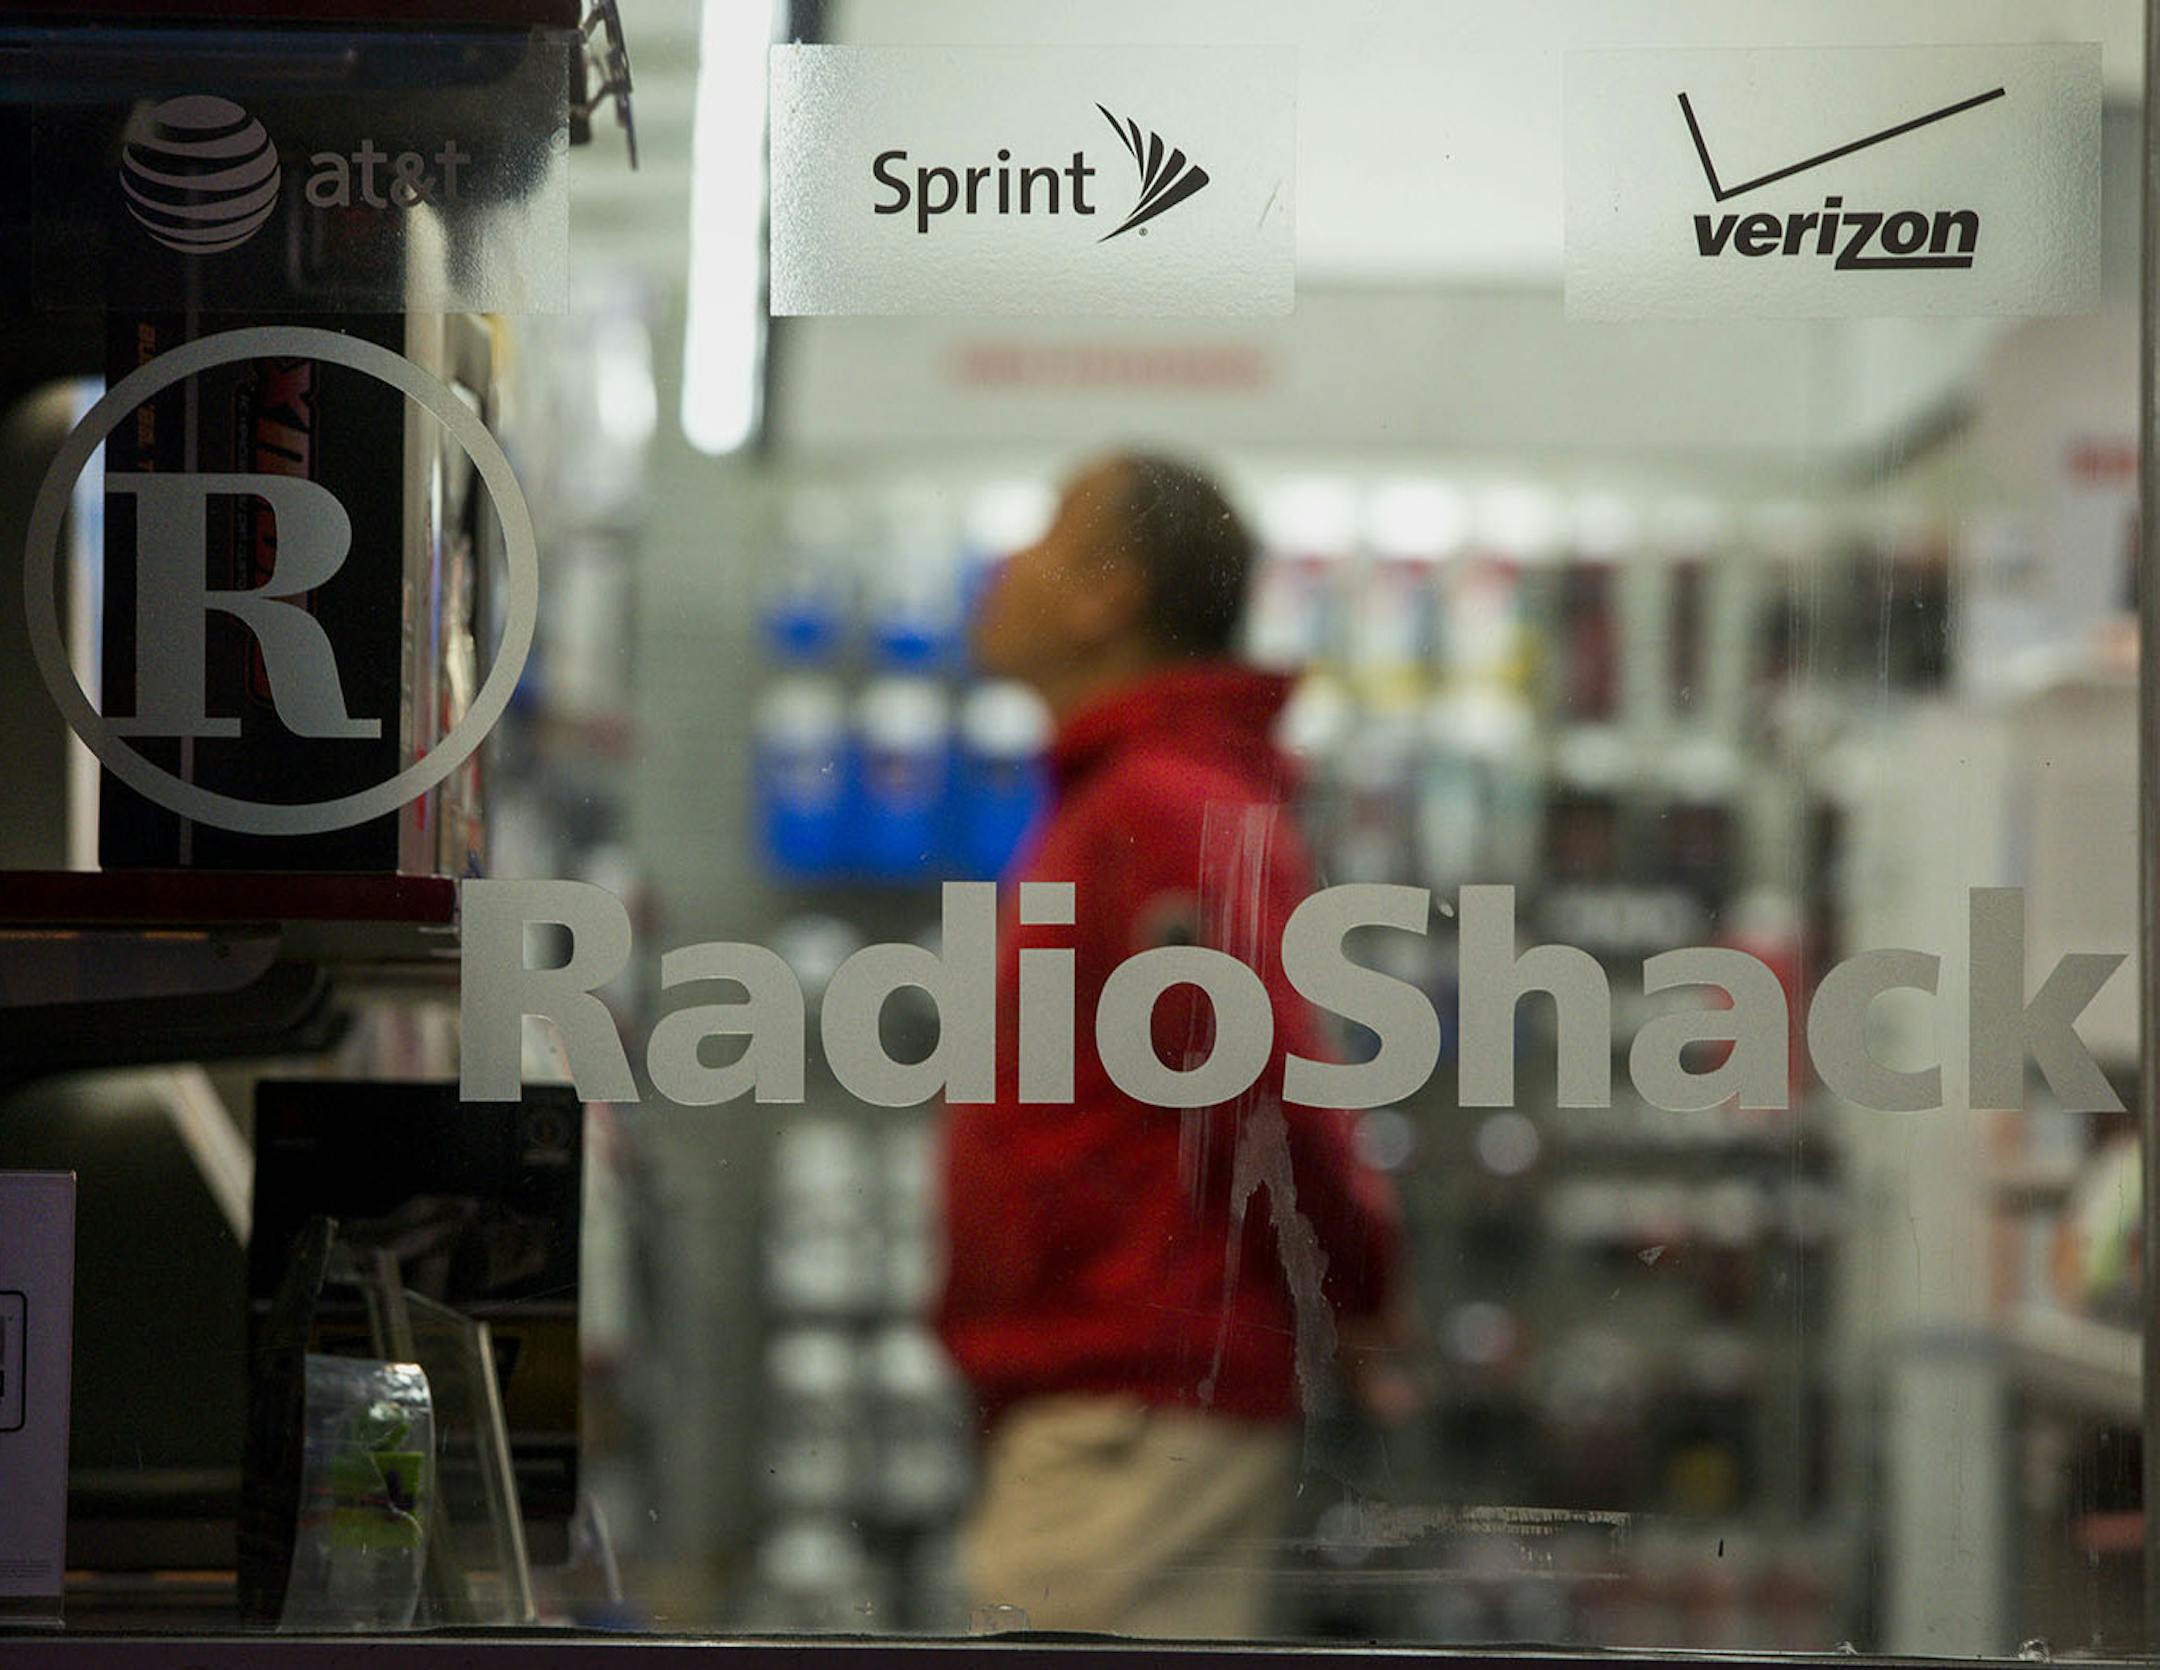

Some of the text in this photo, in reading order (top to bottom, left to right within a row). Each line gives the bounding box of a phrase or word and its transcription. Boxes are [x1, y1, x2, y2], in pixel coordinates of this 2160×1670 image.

[304, 139, 471, 209] at&t
[872, 149, 1096, 234] Sprint
[1693, 195, 1979, 270] verizon
[103, 471, 382, 739] R
[459, 878, 2128, 1114] RadioShack
